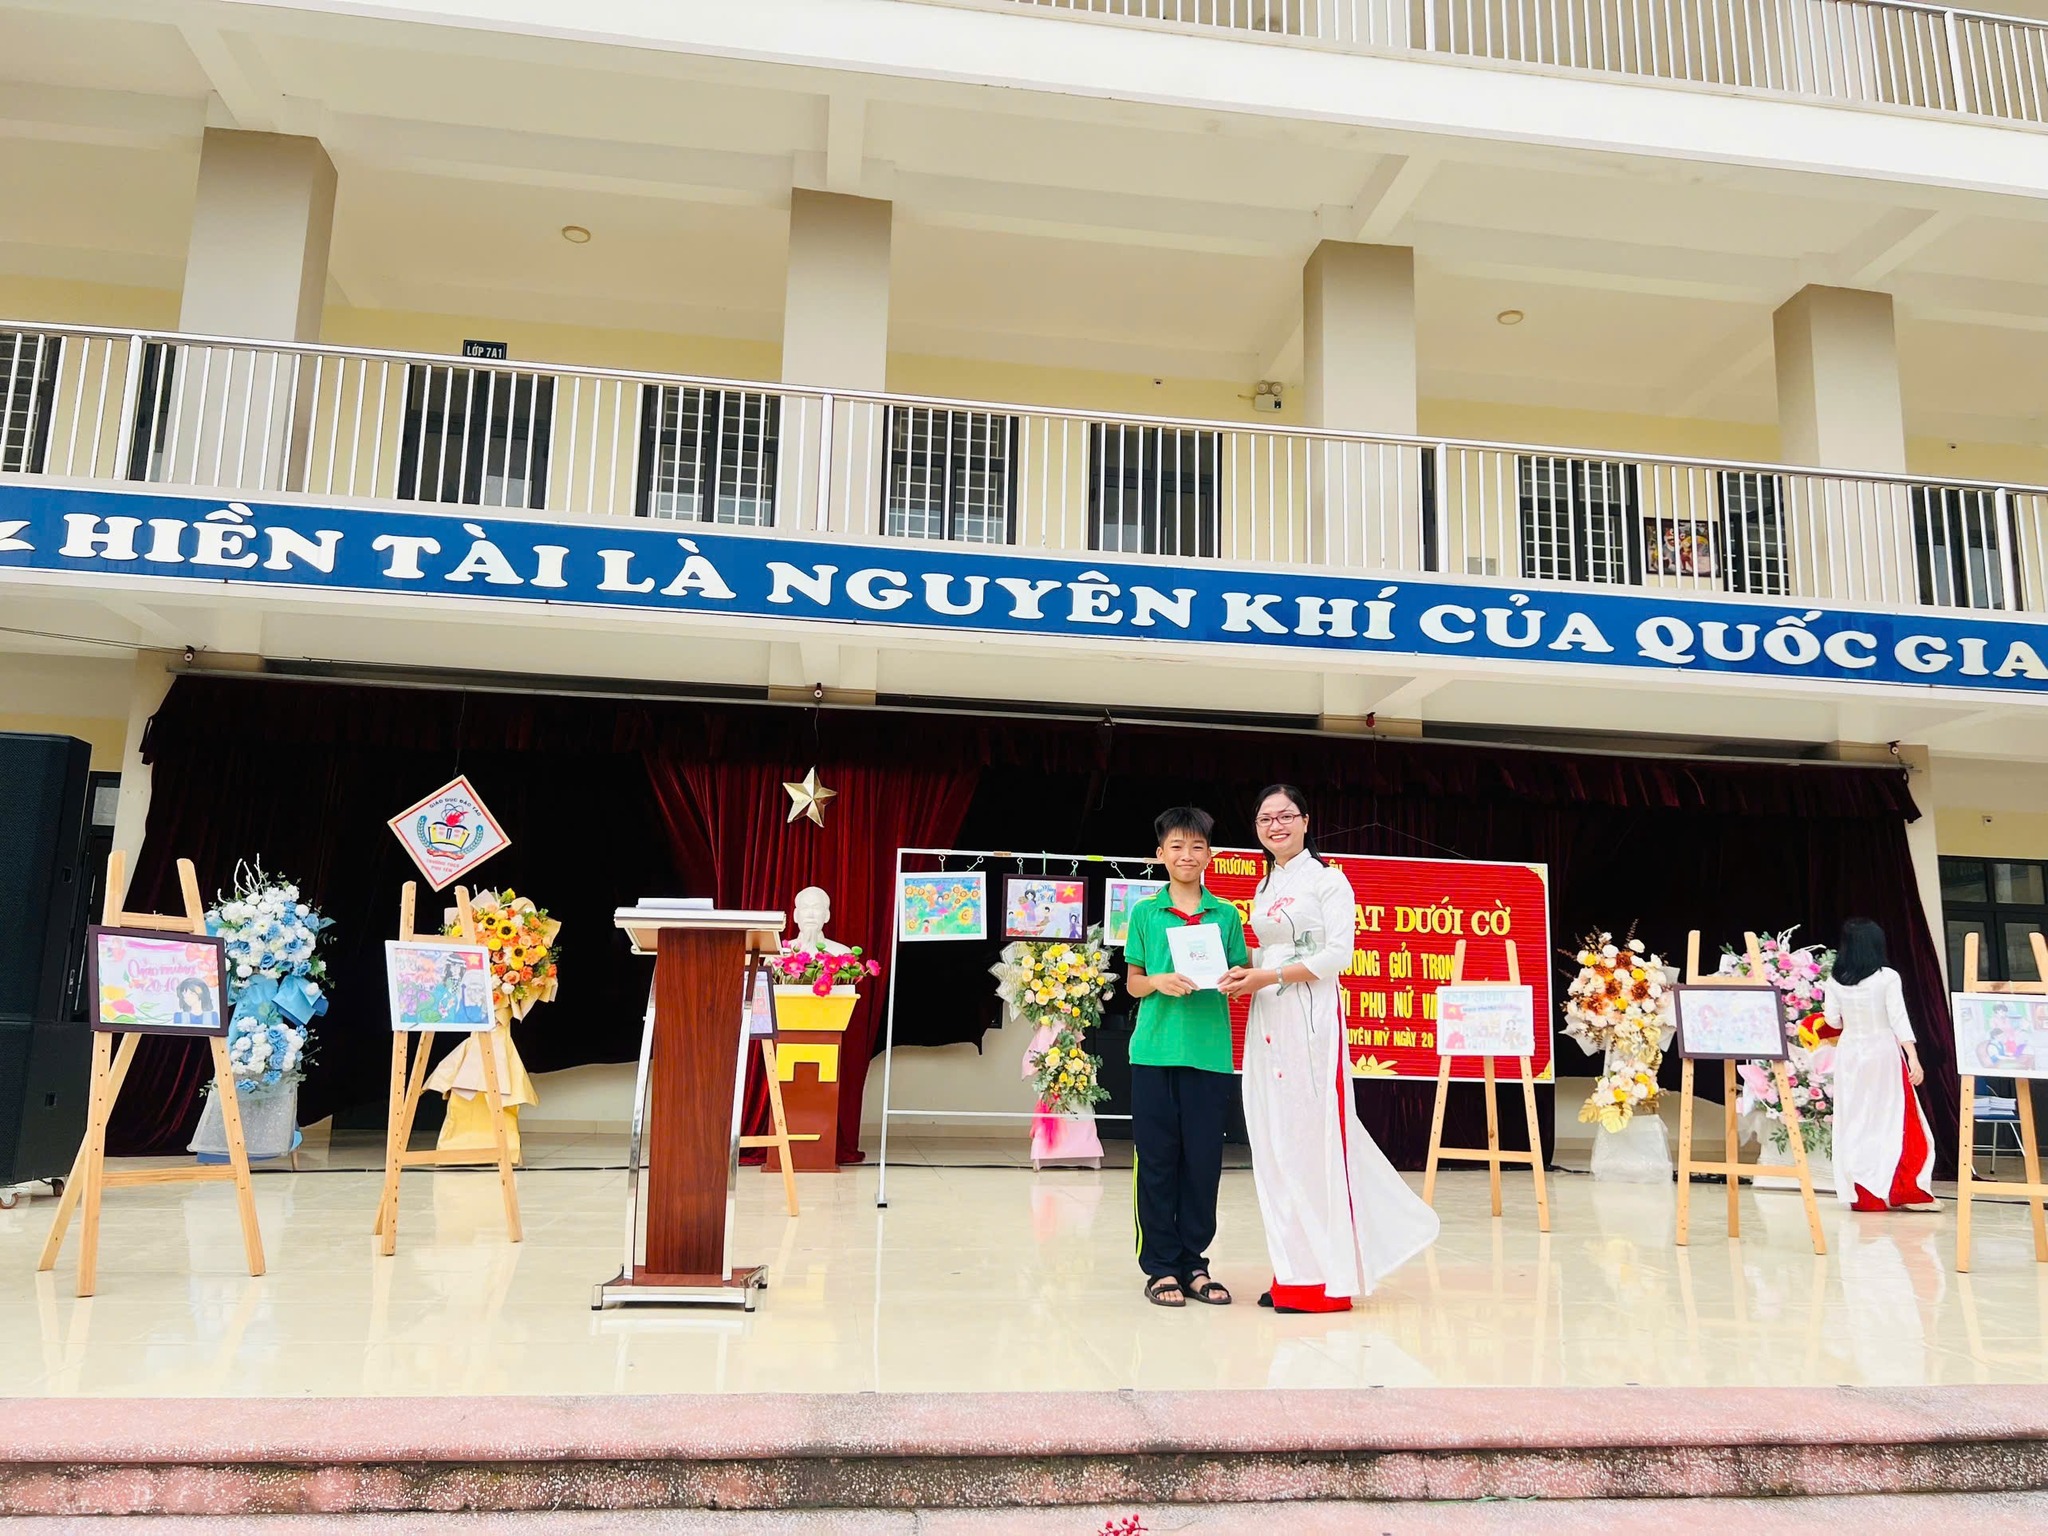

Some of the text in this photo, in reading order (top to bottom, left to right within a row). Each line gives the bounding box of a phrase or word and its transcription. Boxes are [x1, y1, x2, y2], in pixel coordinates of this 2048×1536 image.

[466, 343, 503, 359] LỚP 7A1
[59, 502, 2048, 681] HIỀN TÀI LÀ NGUYÊN KHÍ CỦA QUỐC GIA
[1212, 854, 1256, 876] TRƯỜNG
[1394, 896, 1463, 935] DƯỚI
[1471, 899, 1511, 936] CỜ
[1360, 991, 1386, 1024] PHỤ
[1394, 985, 1415, 1019] NỮ
[1393, 1026, 1416, 1047] NGÀY
[1421, 1032, 1434, 1048] 20
